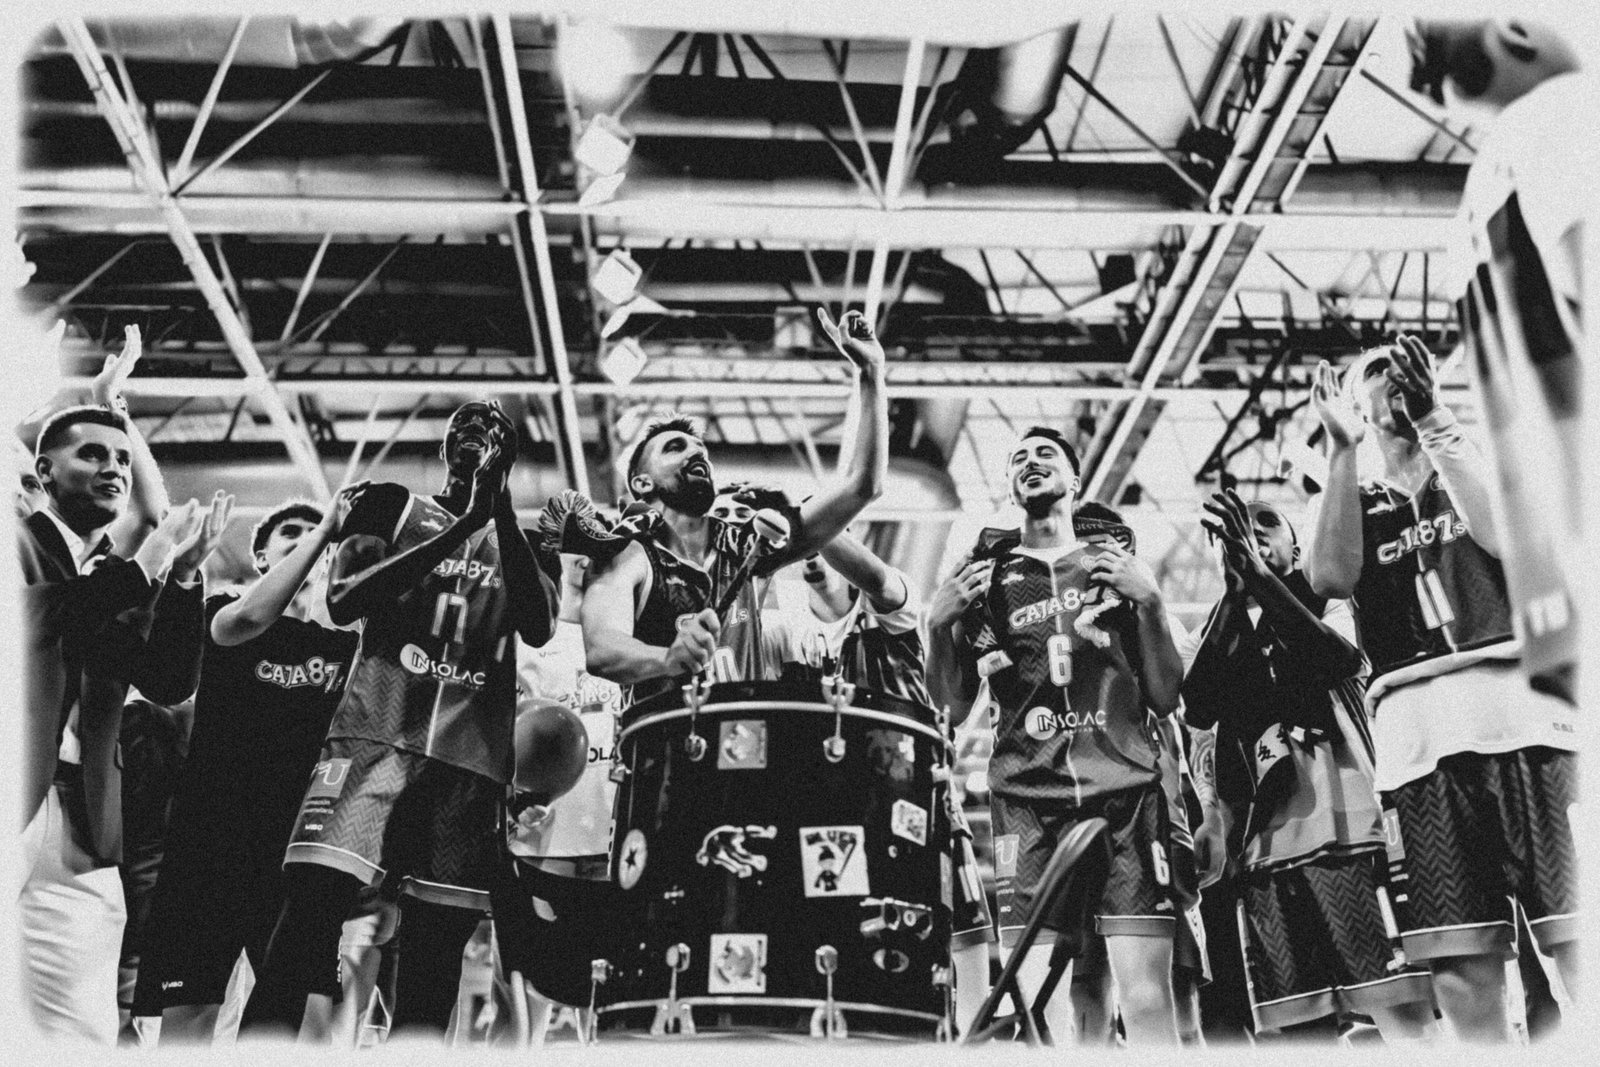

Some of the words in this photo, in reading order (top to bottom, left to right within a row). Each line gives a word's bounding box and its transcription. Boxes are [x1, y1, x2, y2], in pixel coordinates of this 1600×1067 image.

[1009, 587, 1087, 630] CAJA8
[411, 651, 486, 686] INSOLAC
[1047, 634, 1072, 687] 6
[1037, 710, 1106, 732] INSOLAC
[1151, 840, 1170, 886] 6
